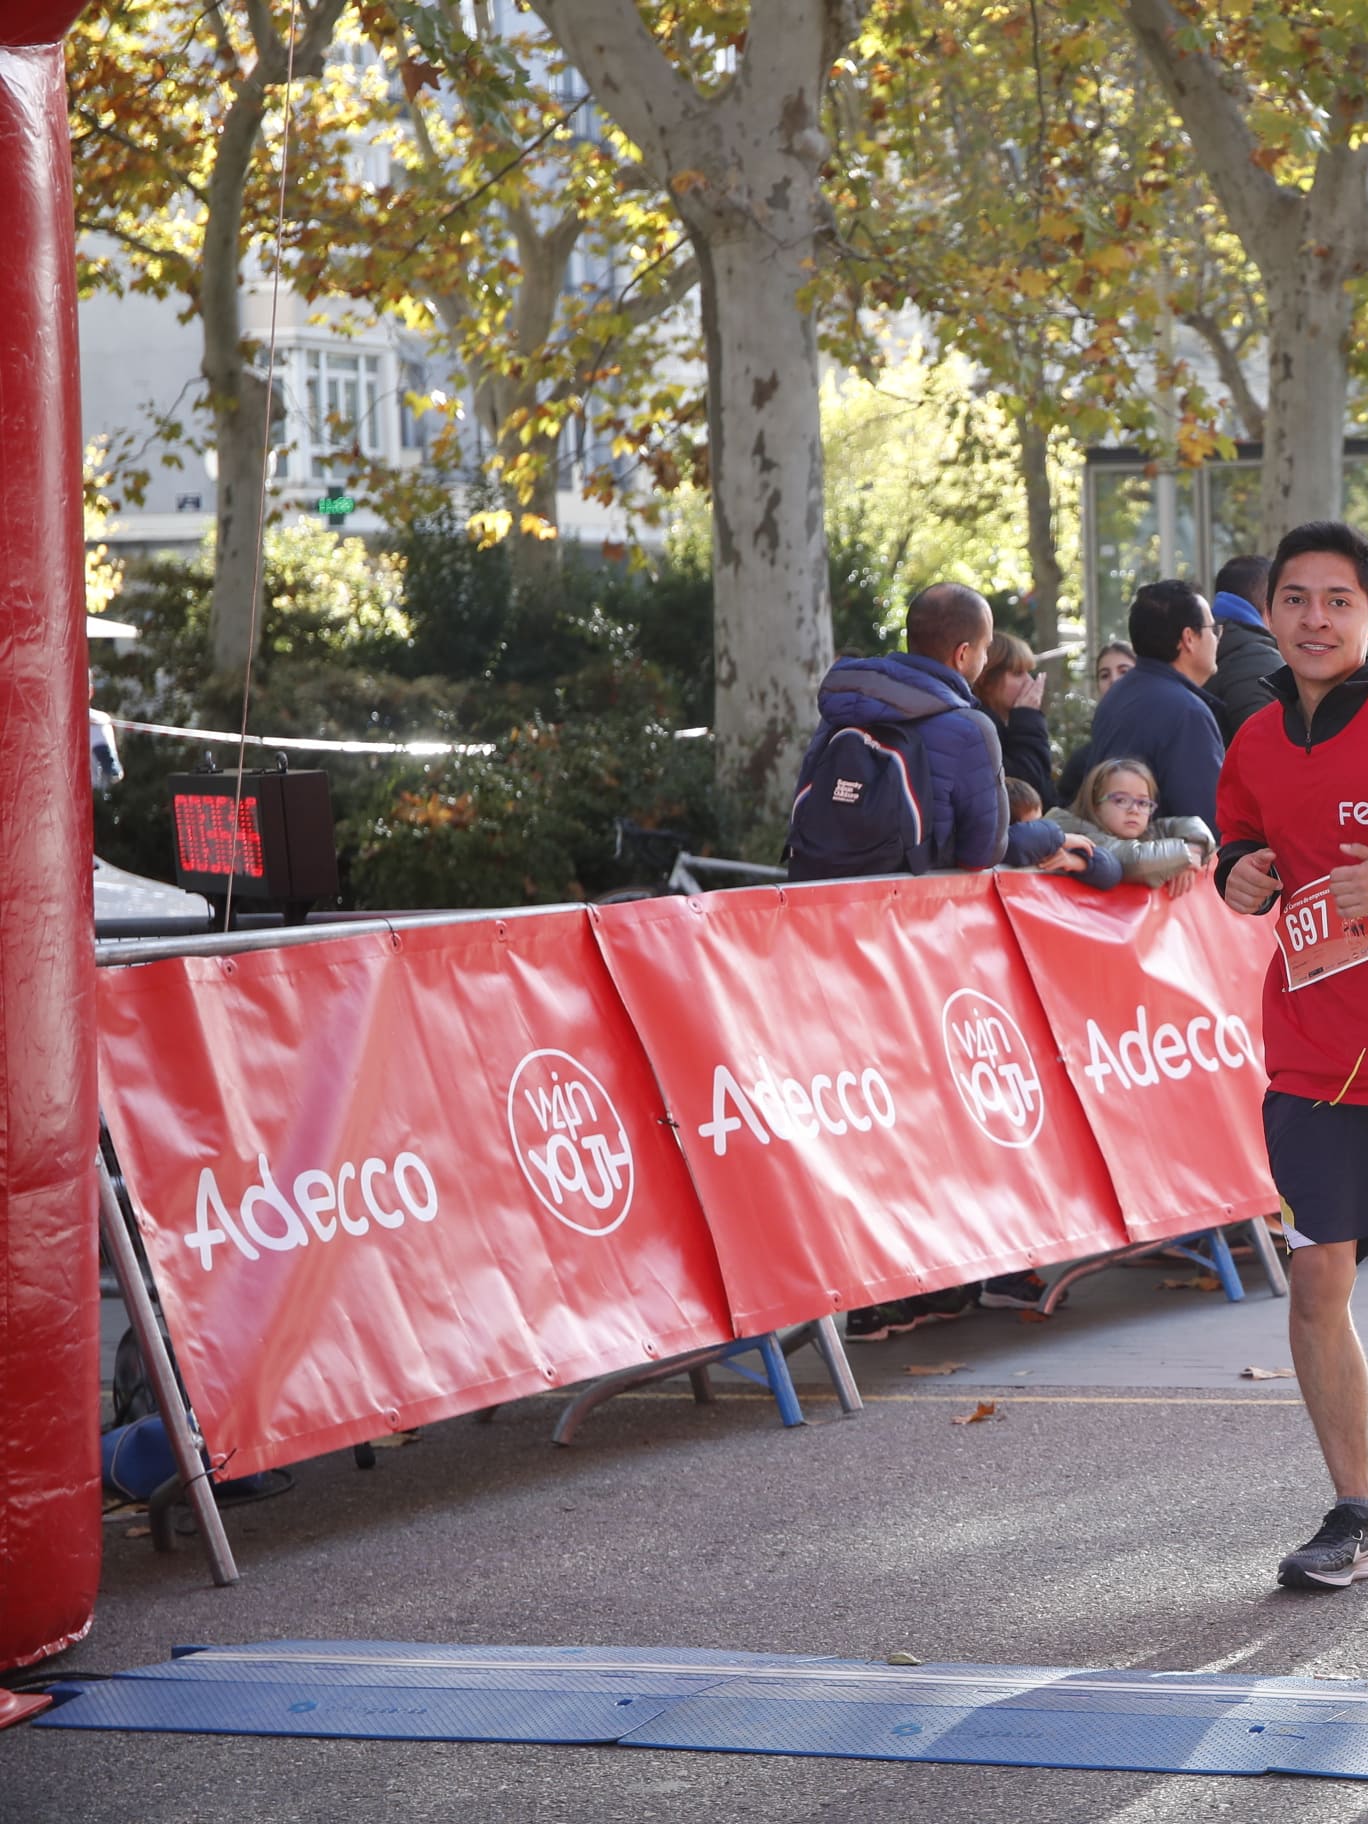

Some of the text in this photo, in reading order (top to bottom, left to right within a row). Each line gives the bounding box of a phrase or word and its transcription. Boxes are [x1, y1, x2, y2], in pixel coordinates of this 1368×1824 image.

[1285, 899, 1329, 952] 697
[1084, 1005, 1258, 1094] Adecco
[698, 1056, 896, 1156] Adecco
[960, 1061, 1040, 1127] YOUTH
[528, 1129, 631, 1209] YOUTH
[184, 1152, 438, 1271] Adecco
